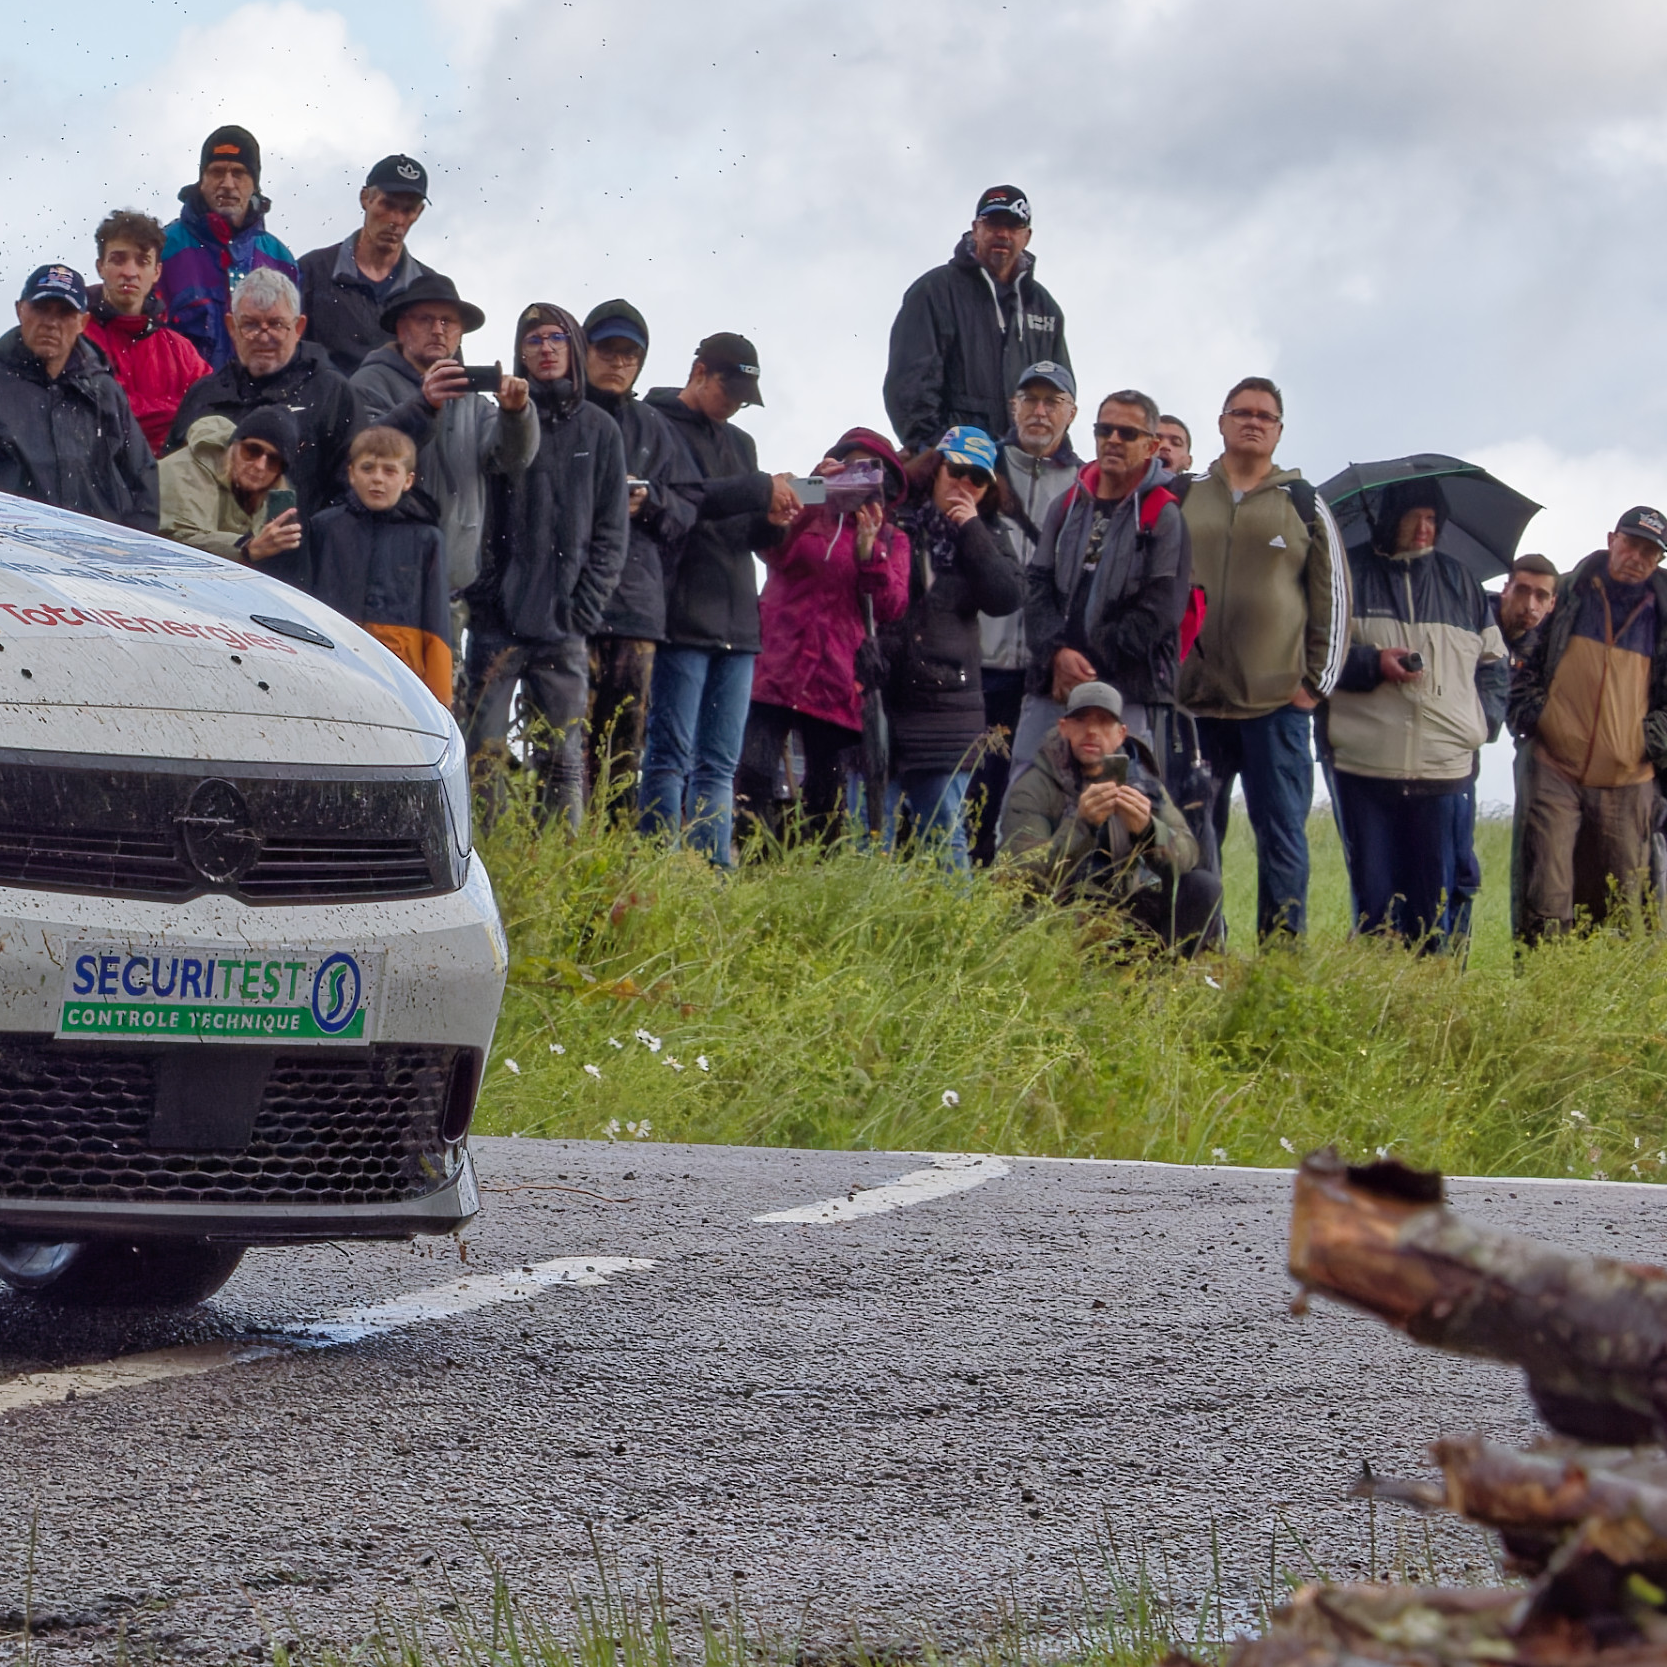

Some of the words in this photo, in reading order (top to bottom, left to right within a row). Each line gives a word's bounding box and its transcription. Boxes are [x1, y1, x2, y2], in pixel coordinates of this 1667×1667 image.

[72, 954, 308, 1001] SECURITEST
[67, 1008, 180, 1029] CONTROLE
[188, 1011, 301, 1034] TECHNIQUE
